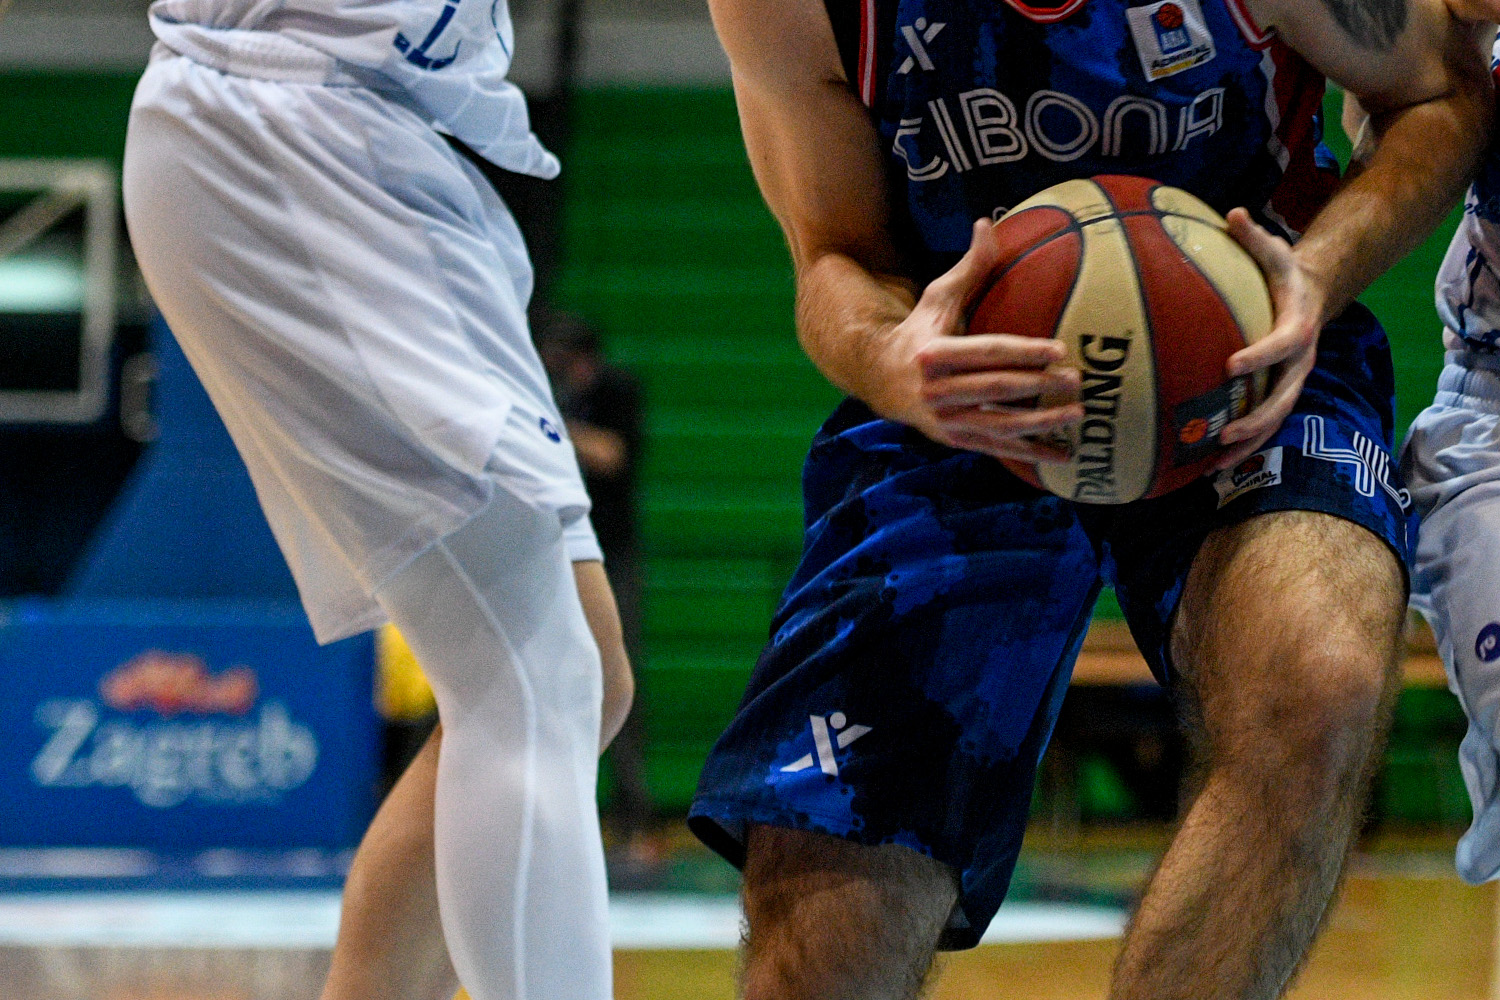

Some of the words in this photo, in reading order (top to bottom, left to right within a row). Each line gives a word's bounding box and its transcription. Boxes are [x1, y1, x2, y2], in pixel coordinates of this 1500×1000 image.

[892, 86, 1226, 182] CIBONA
[1072, 332, 1134, 499] PALDING
[30, 697, 321, 807] Zagreb
